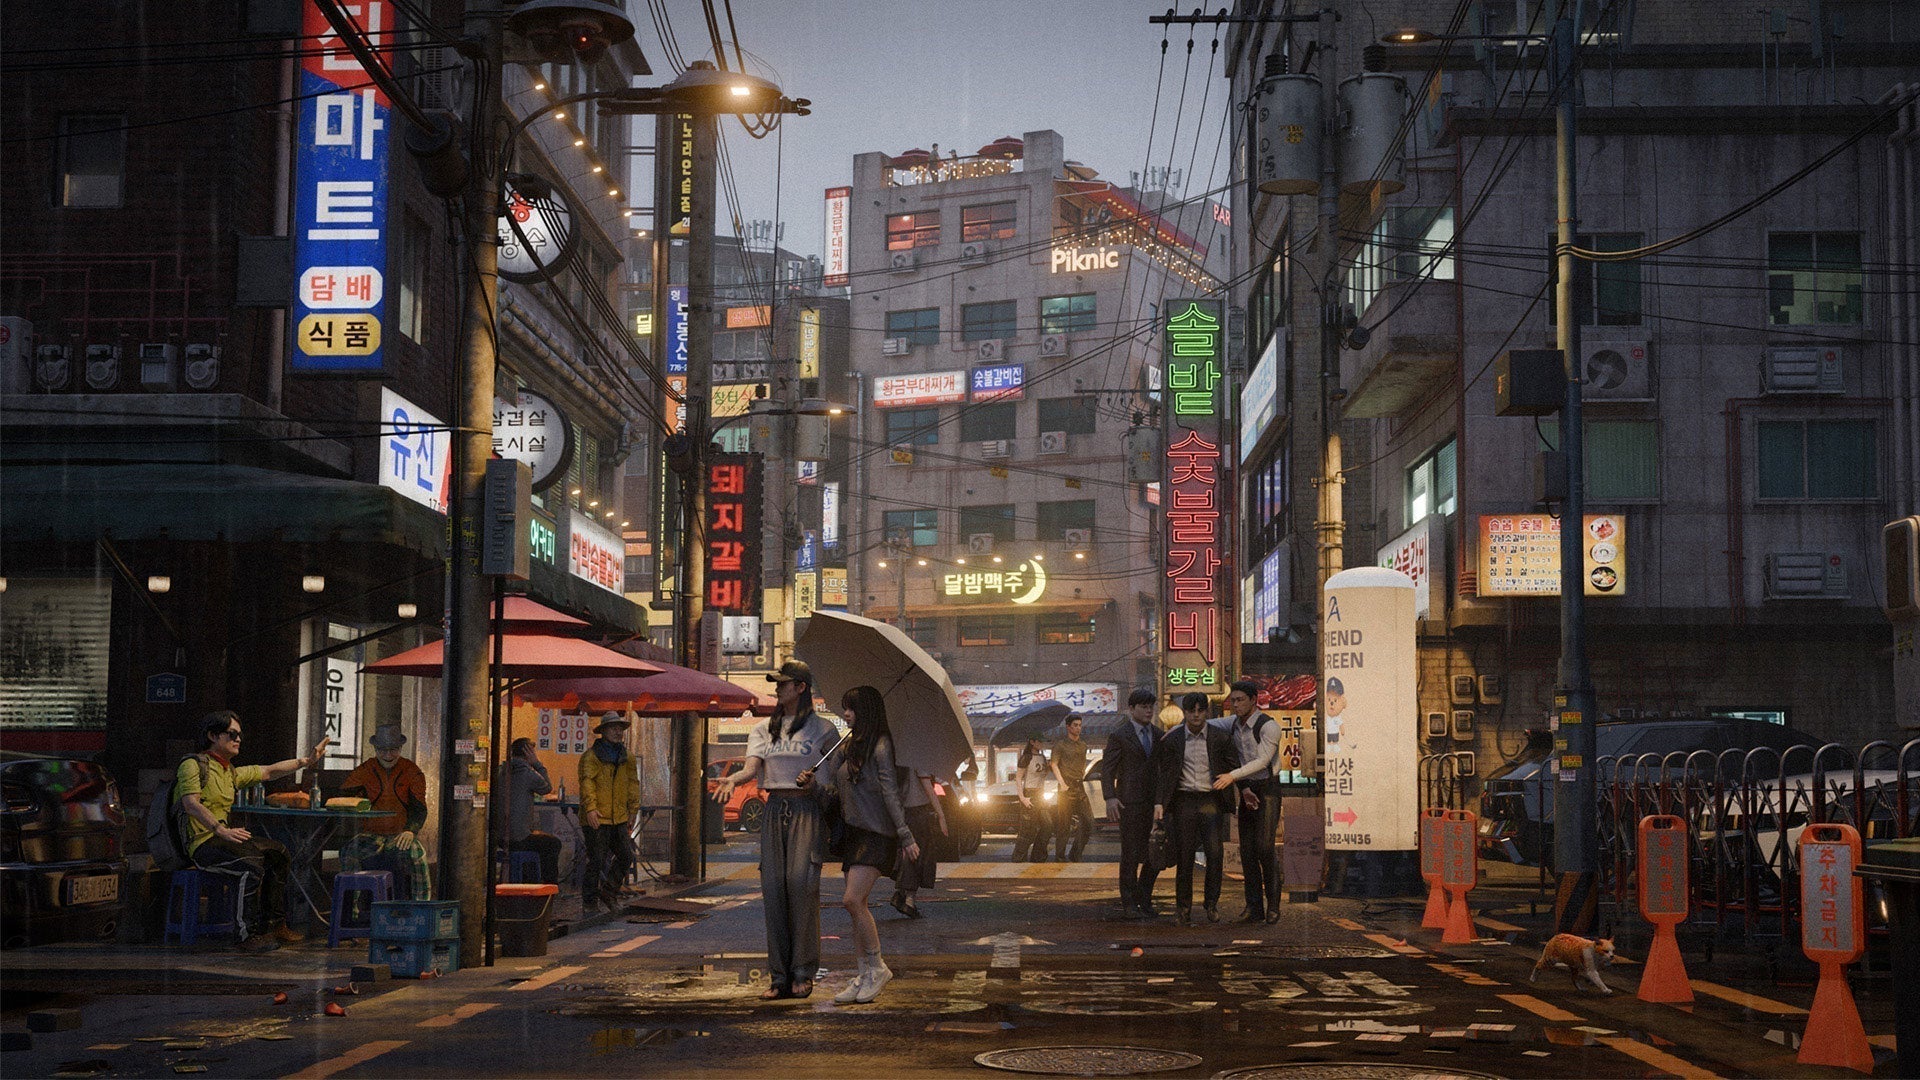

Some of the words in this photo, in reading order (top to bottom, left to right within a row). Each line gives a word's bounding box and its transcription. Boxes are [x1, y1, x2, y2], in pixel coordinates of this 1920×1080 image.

[1051, 247, 1119, 273] Piknic
[310, 275, 372, 301] 담배
[308, 321, 371, 348] 식품
[1166, 303, 1221, 415] 솔밭
[882, 374, 955, 395] 황금부대찌개
[974, 367, 1022, 388] 숯불갈비집
[390, 407, 434, 492] 유진
[710, 464, 745, 610] 돼지갈비
[1166, 430, 1221, 662] 숯불갈비
[944, 572, 1024, 595] 달밤맥주
[1168, 667, 1216, 684] 생등심
[156, 687, 176, 698] 648
[1819, 845, 1839, 949] 주차금지
